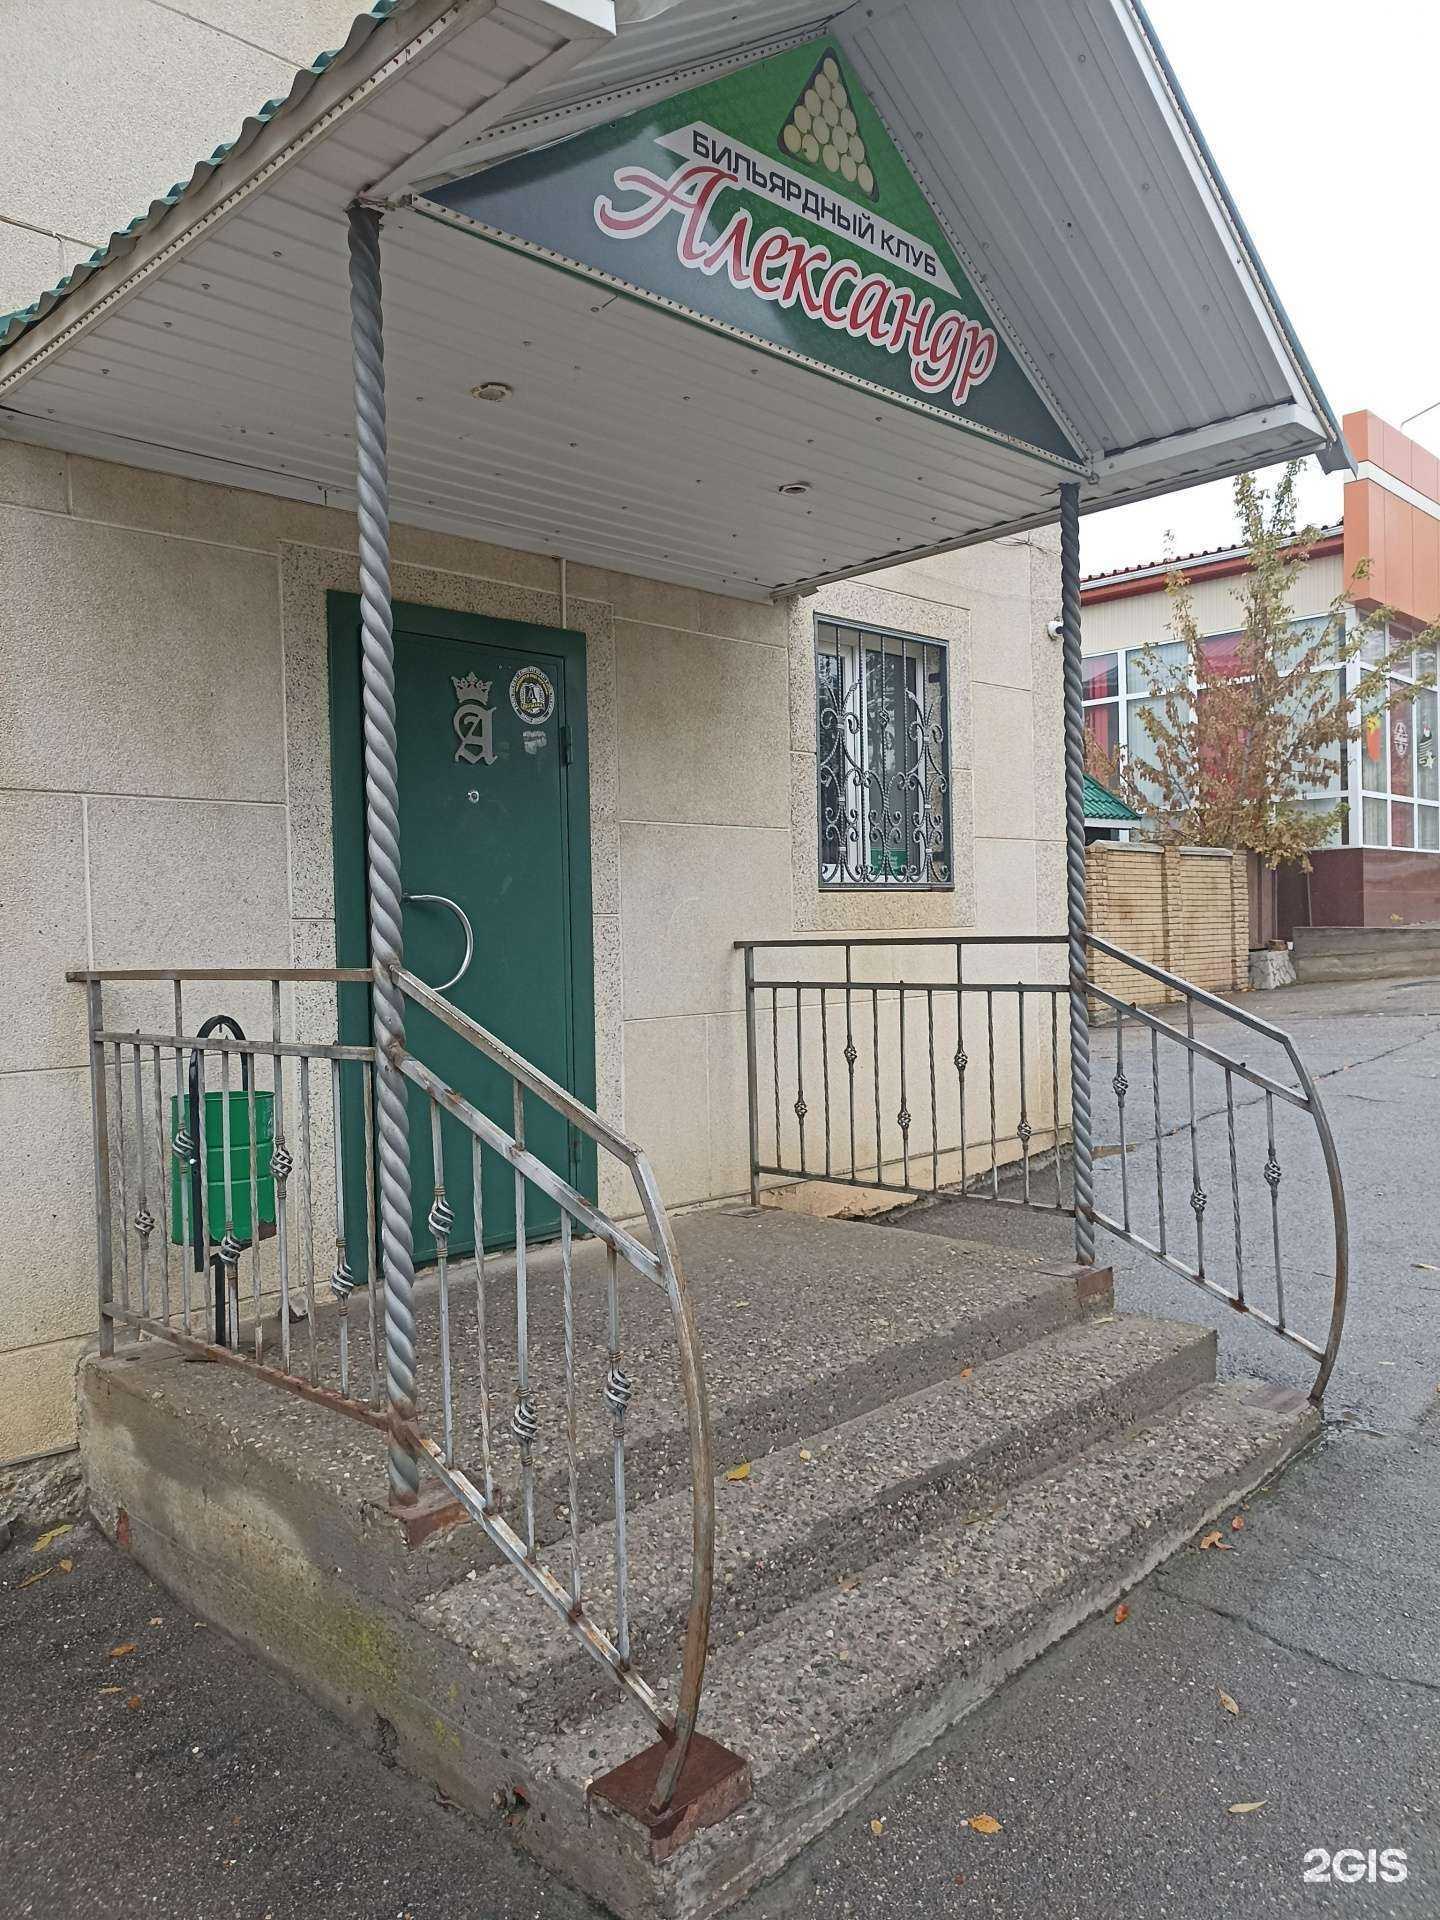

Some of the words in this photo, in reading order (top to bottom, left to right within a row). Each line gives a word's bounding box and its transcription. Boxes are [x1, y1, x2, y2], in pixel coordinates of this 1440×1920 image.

[597, 162, 997, 402] Александр
[692, 130, 874, 244] БИЛЬЯРДНЫЙ
[881, 229, 936, 276] КЛУБ
